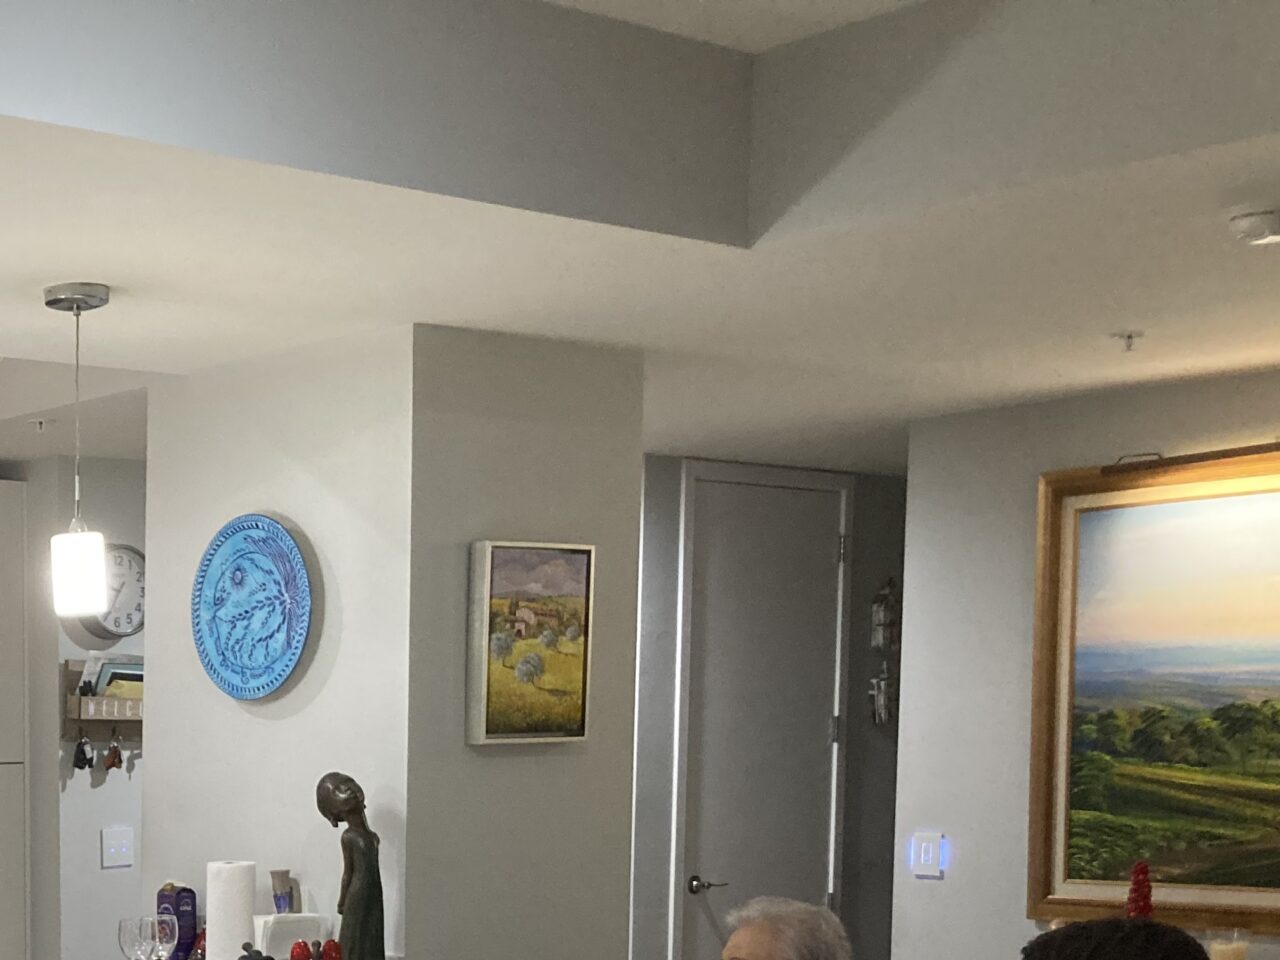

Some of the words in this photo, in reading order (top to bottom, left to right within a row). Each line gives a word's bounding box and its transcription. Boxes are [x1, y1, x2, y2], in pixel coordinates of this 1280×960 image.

[135, 602, 141, 612] 4
[114, 616, 121, 628] 6
[126, 613, 133, 625] 5
